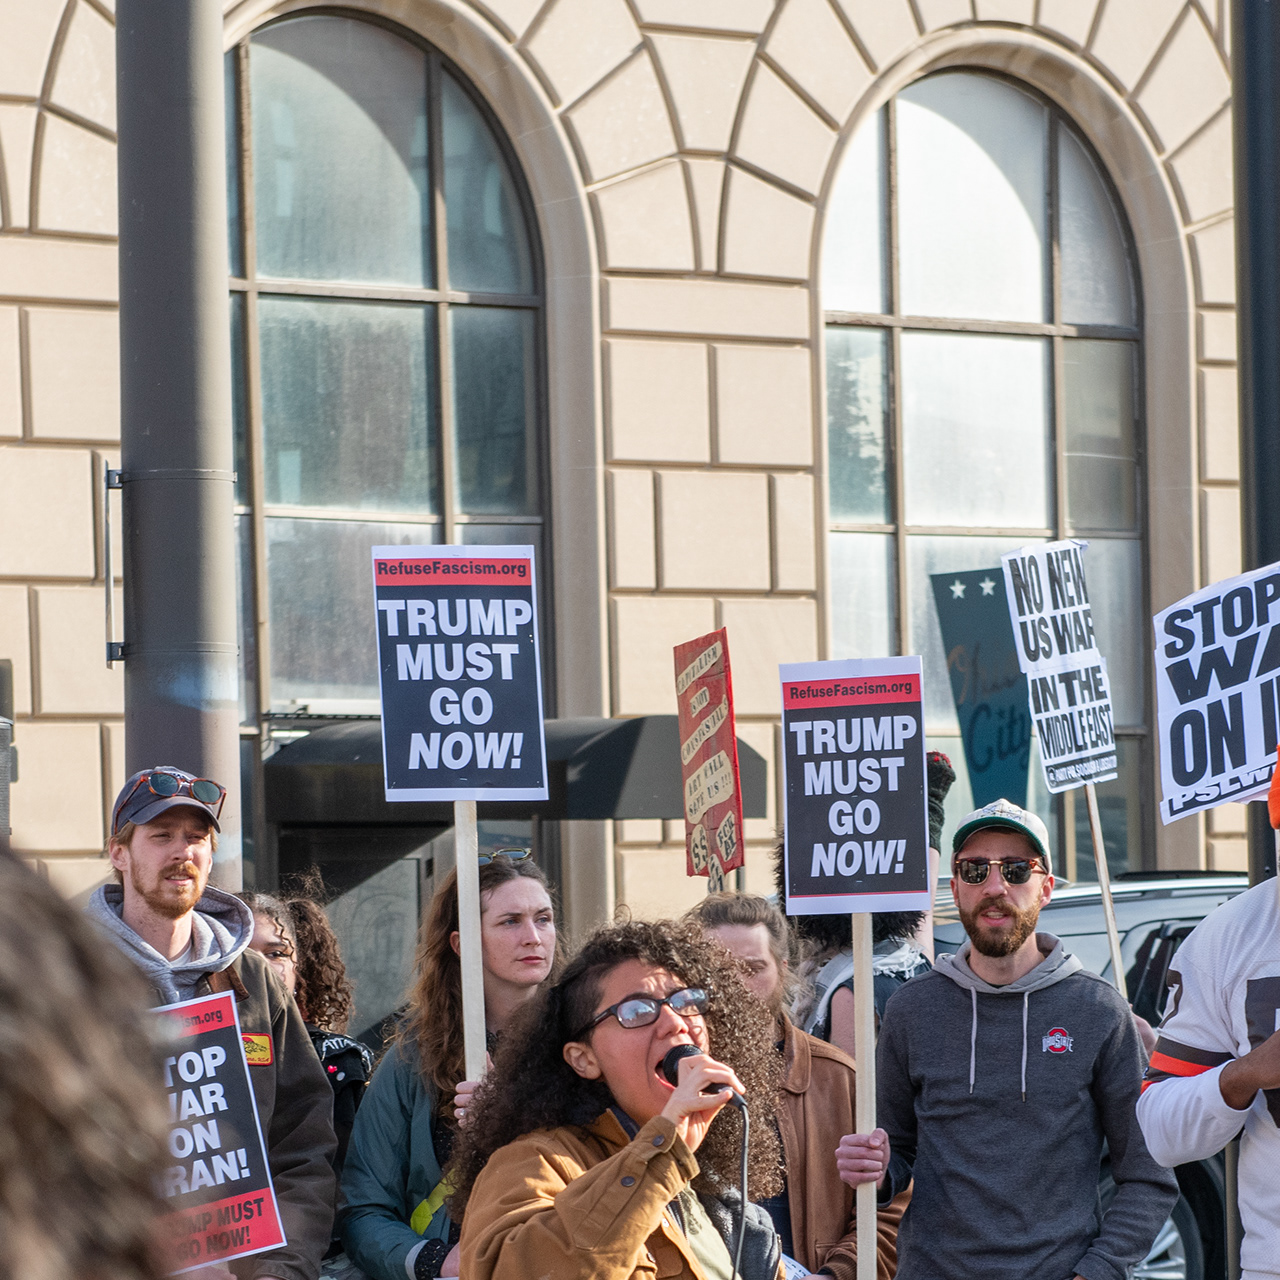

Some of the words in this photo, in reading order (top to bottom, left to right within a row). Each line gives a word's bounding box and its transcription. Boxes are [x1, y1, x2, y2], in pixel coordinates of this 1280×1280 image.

[377, 561, 527, 577] RefuseFascism.org
[1008, 554, 1044, 617] NO
[1046, 547, 1090, 611] NEW
[377, 599, 533, 636] TRUMP
[1018, 616, 1053, 663] US
[396, 642, 520, 681] MUST
[429, 687, 494, 725] GO
[790, 681, 913, 699] RefuseFascism.org
[1030, 675, 1060, 714] IN
[1058, 665, 1108, 708] THE
[408, 731, 524, 770] NOW!
[789, 715, 918, 756] TRUMP
[1036, 710, 1088, 760] MIDDLE
[1085, 703, 1116, 750] EAST
[1170, 691, 1247, 788] ON
[803, 757, 906, 796] MUST
[828, 799, 881, 836] GO
[810, 839, 907, 878] NOW!
[164, 1045, 227, 1088] TOP
[168, 1083, 229, 1122] AR
[168, 1119, 221, 1159] ON
[163, 1148, 251, 1197] RAN!
[217, 1197, 265, 1227] MUST
[206, 1226, 251, 1255] NOW!
